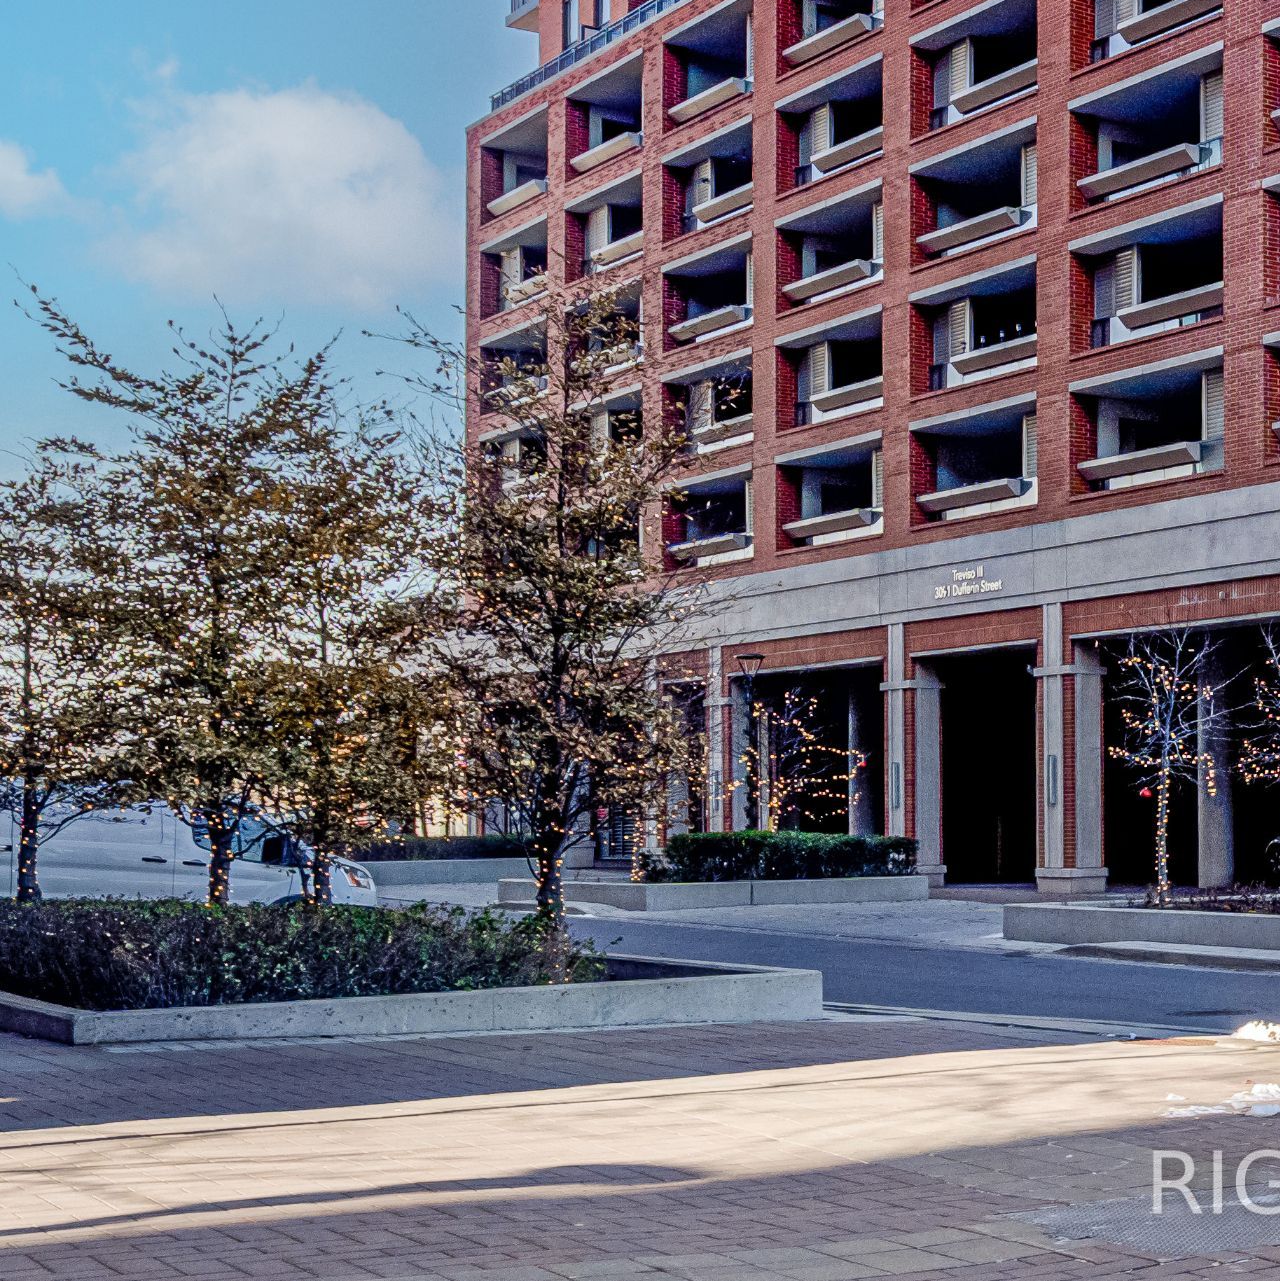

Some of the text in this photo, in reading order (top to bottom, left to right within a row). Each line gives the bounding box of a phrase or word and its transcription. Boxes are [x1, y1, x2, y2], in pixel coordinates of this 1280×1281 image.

[952, 568, 976, 581] Treviso
[952, 582, 980, 597] Dufferin
[980, 579, 1003, 593] Street
